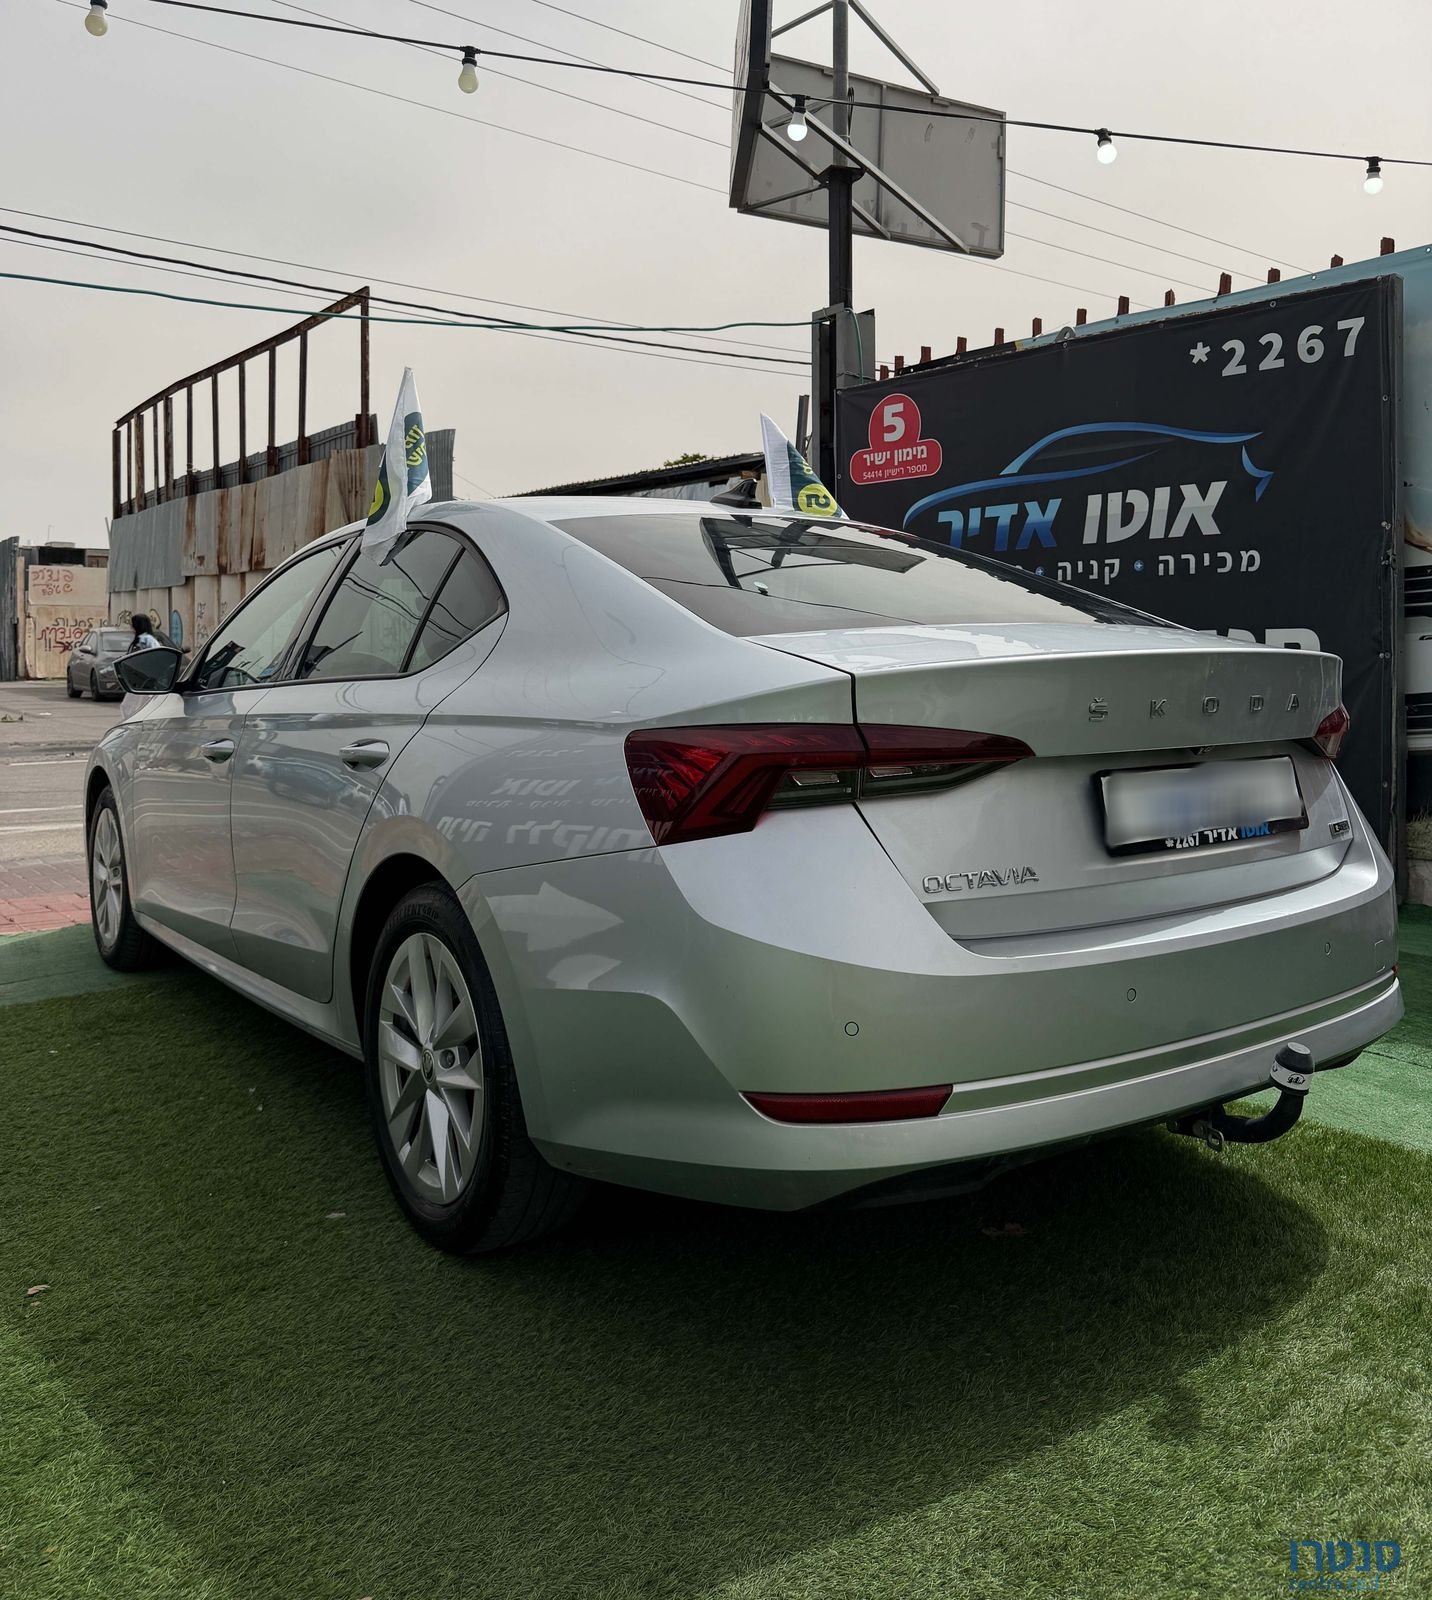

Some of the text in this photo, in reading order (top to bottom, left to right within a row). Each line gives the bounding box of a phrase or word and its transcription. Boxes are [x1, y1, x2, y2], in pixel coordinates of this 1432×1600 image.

[883, 402, 906, 442] 5
[863, 445, 927, 466] מימון ישיר
[862, 463, 928, 480] מספר רישיון 54414
[937, 480, 1229, 552] אוטו אדיר
[1057, 549, 1262, 585] מכירה קניה
[1088, 693, 1300, 722] ŠKODA
[1203, 827, 1239, 844] אדיר
[922, 865, 1040, 894] OCTAVIA
